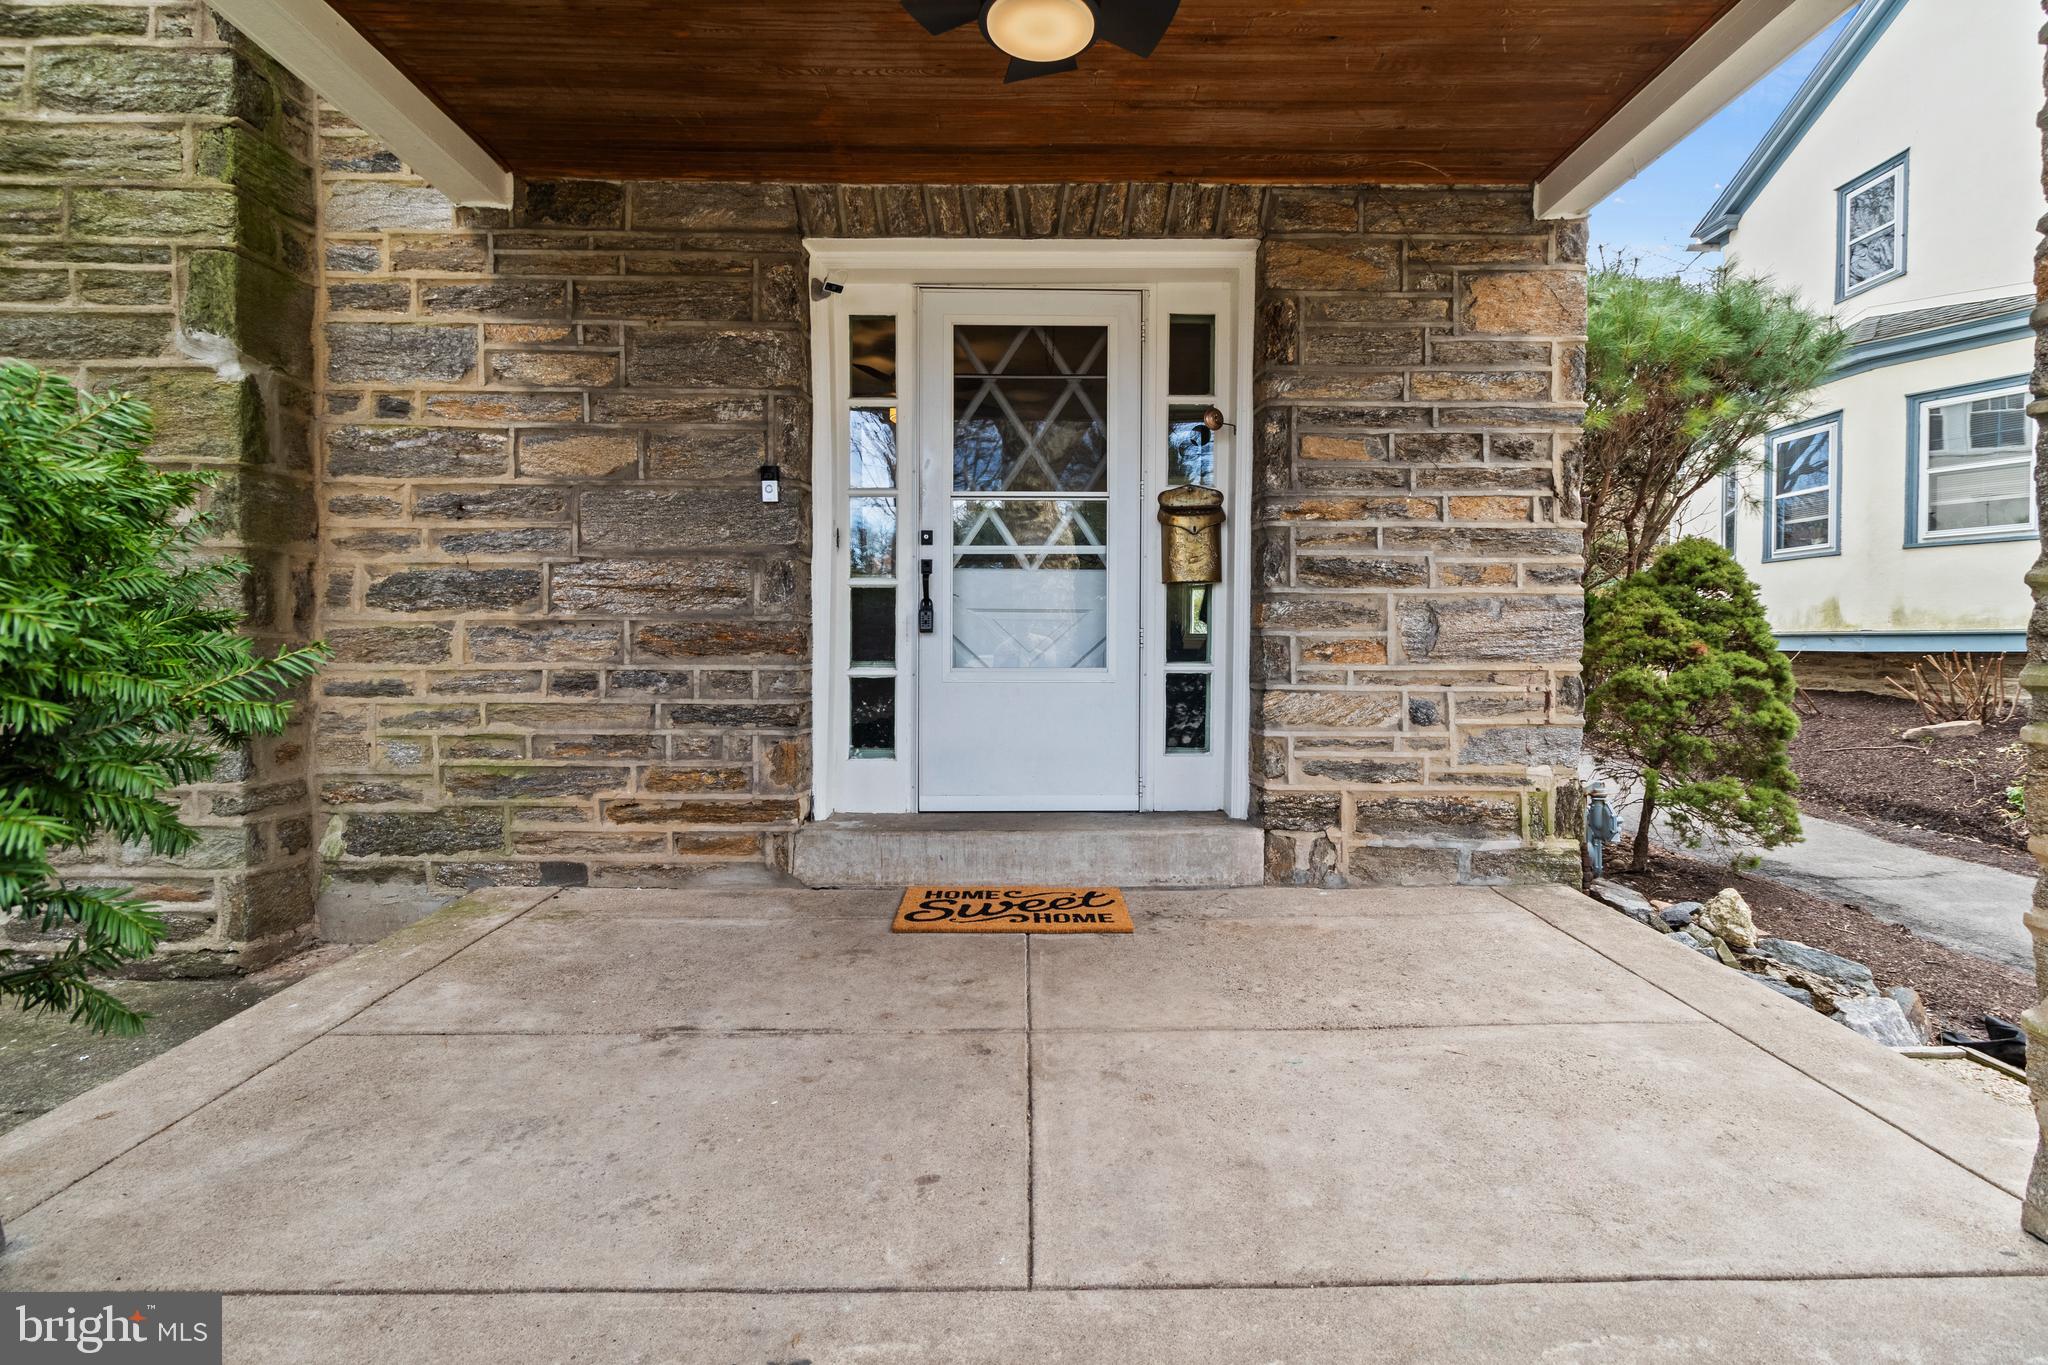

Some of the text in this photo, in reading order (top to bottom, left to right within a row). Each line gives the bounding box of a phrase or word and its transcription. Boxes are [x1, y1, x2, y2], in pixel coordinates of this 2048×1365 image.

[924, 890, 1000, 900] HOME
[904, 890, 1116, 923] Sweet
[1033, 912, 1115, 924] HOME
